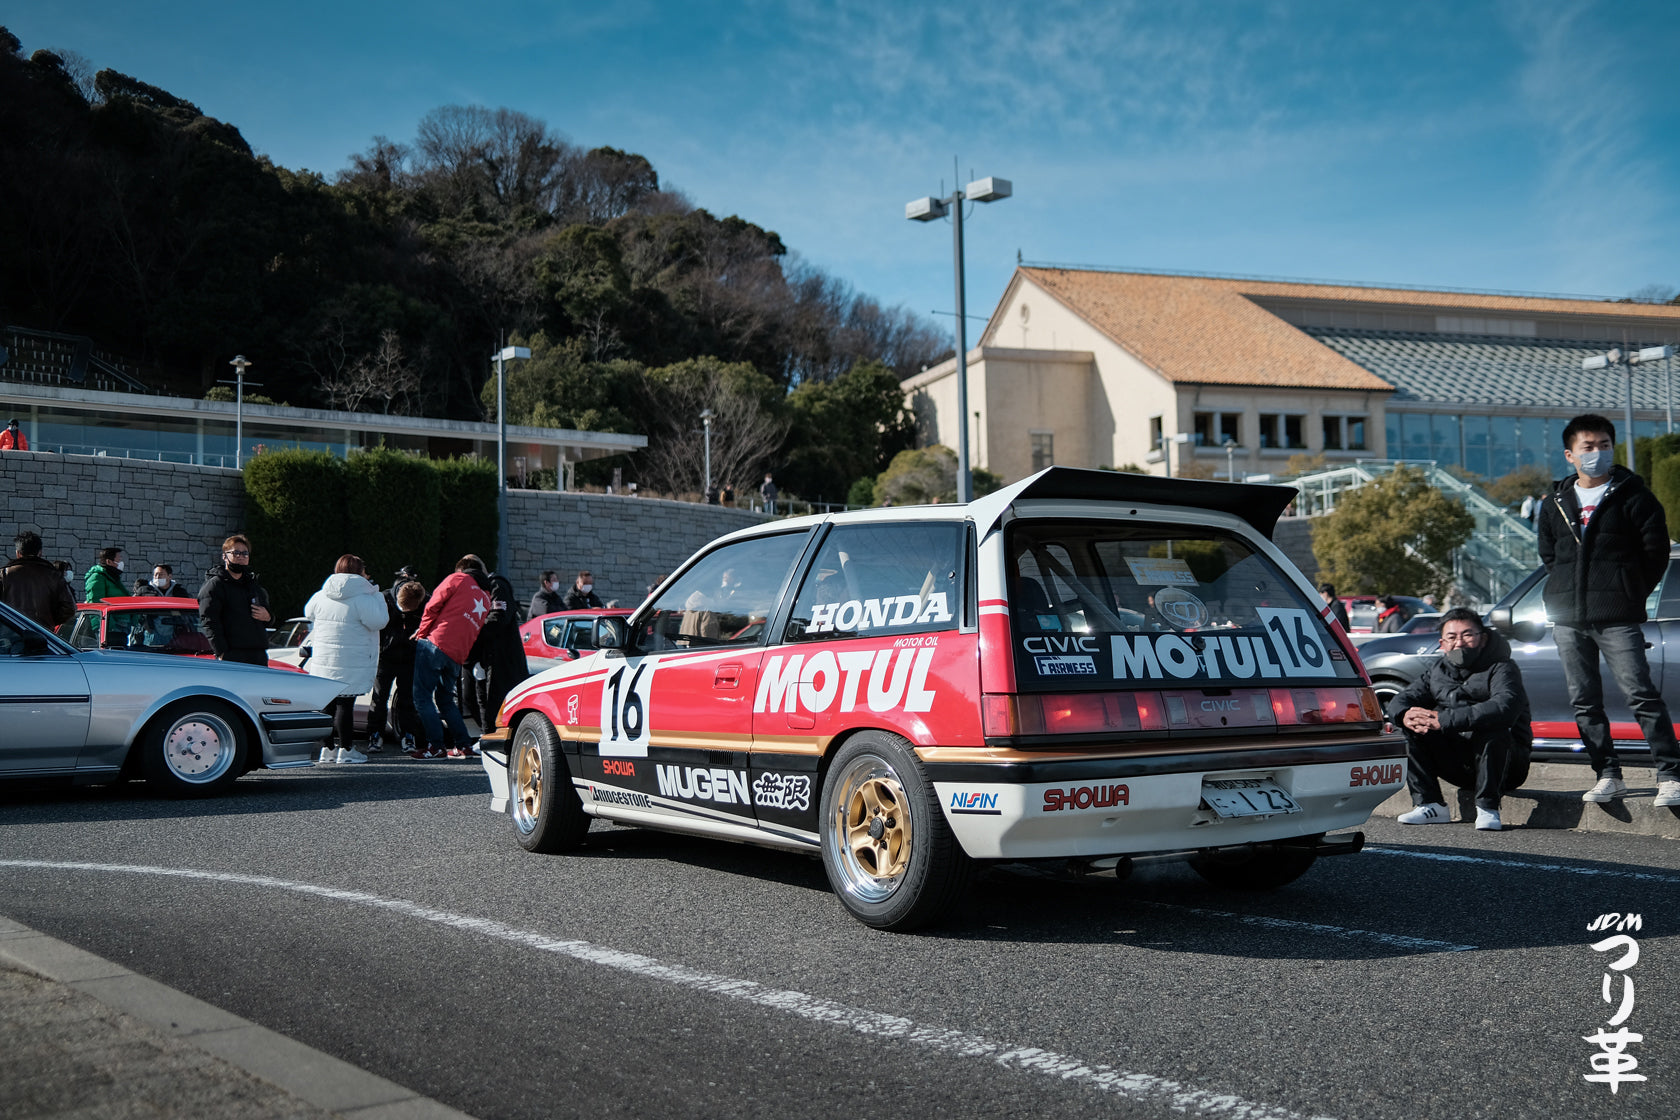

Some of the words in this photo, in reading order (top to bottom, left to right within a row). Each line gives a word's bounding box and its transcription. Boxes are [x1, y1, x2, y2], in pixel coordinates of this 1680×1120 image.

[805, 592, 953, 633] HONDA
[893, 637, 924, 647] MOTOR
[924, 636, 939, 646] OIL
[1023, 636, 1100, 653] CIVIC
[1268, 615, 1324, 668] 16
[1035, 656, 1095, 675] FAIRNESS
[1110, 633, 1282, 679] MOTUL
[753, 647, 936, 713] MOTUL
[608, 663, 648, 741] 16
[1200, 699, 1241, 712] CIVIC
[602, 760, 636, 776] SHOWA
[1350, 764, 1403, 787] SHOWA
[590, 785, 653, 808] BRIDGESTONE
[656, 764, 751, 805] MUGEN
[754, 773, 810, 810] 無限
[950, 792, 999, 809] NISSIN
[1043, 784, 1130, 811] SHOWA
